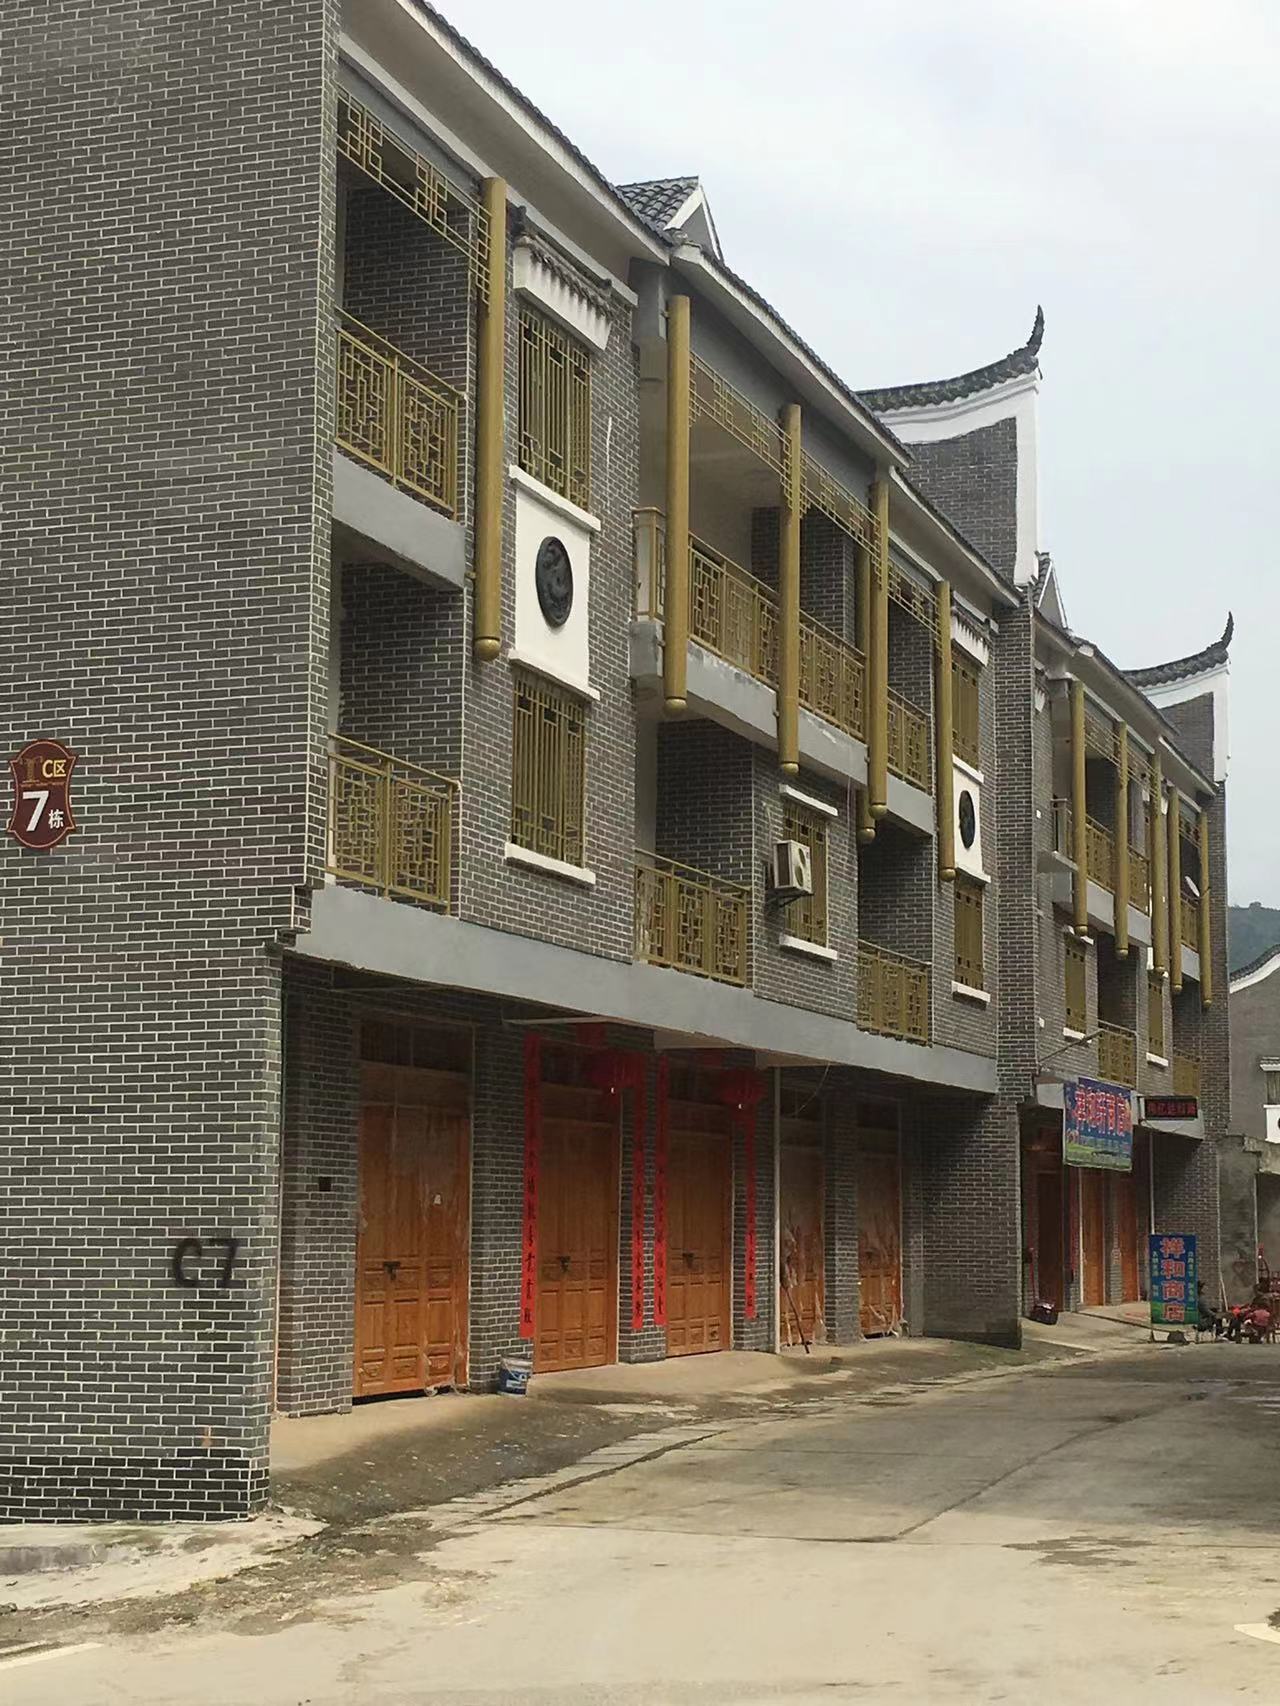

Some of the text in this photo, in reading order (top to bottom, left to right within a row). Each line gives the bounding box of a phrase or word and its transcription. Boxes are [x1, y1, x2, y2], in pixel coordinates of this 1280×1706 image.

[42, 759, 67, 778] C区
[22, 790, 64, 832] 7栋
[172, 1237, 240, 1288] C7
[1160, 1237, 1185, 1322] 祥和商店
